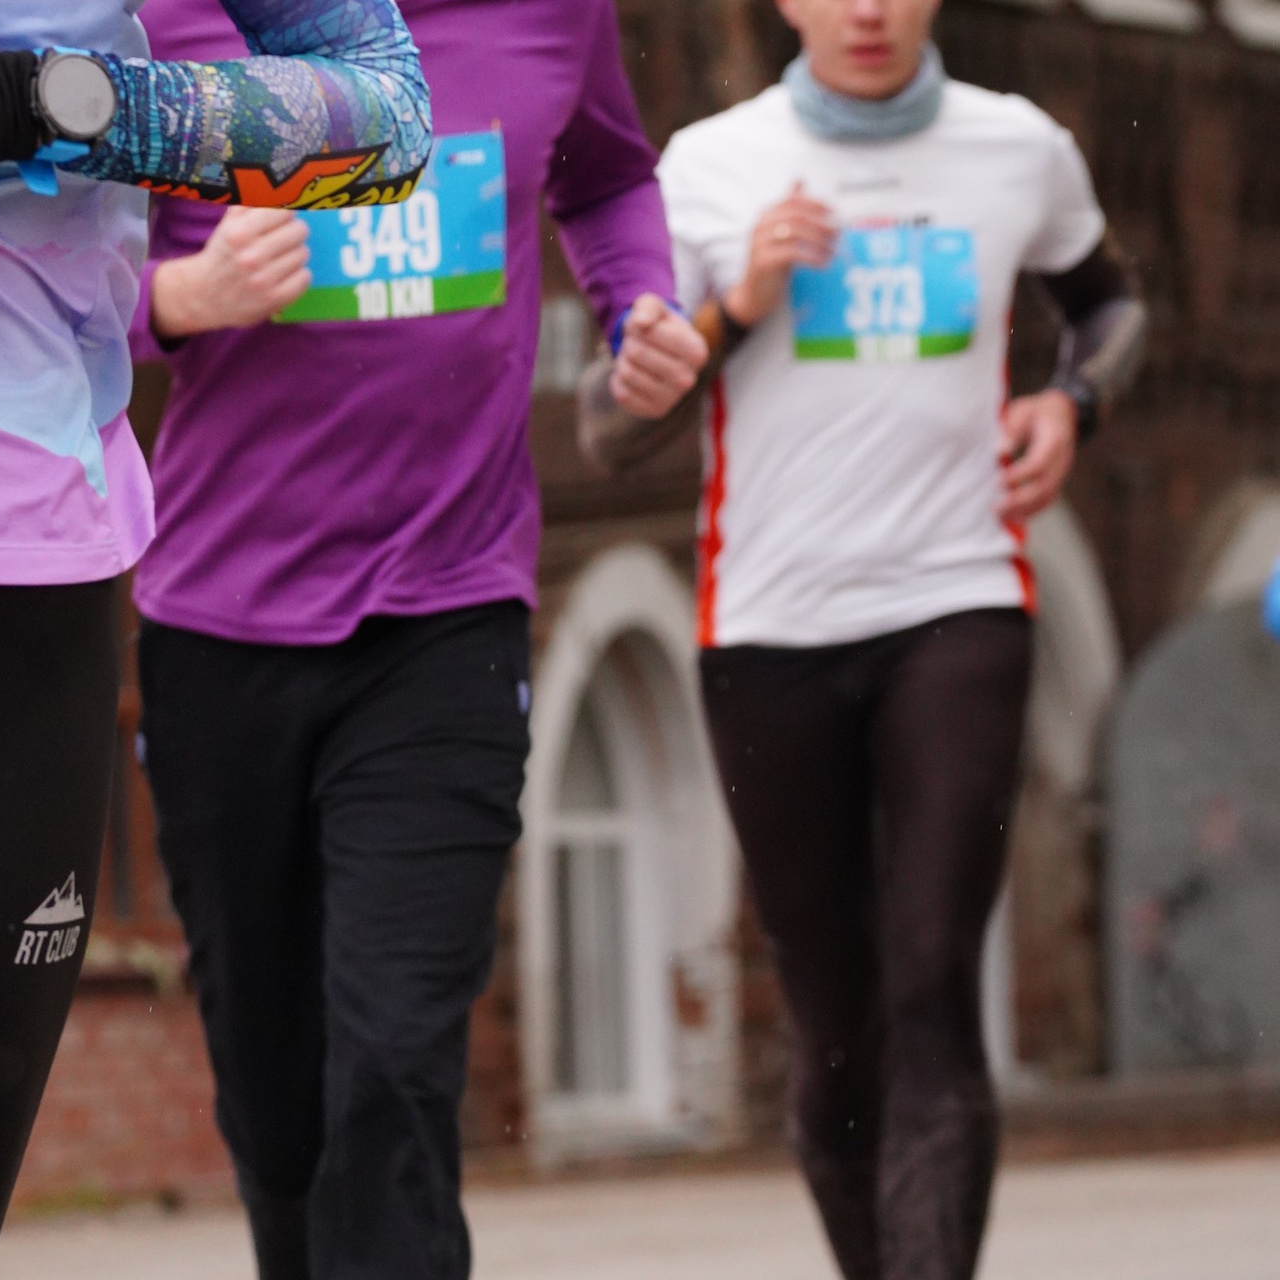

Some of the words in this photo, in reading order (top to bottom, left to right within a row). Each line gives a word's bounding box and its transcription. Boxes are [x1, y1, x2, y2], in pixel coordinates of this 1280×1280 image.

[339, 189, 442, 278] 349
[14, 930, 49, 965] RT
[46, 925, 81, 964] CLUB
